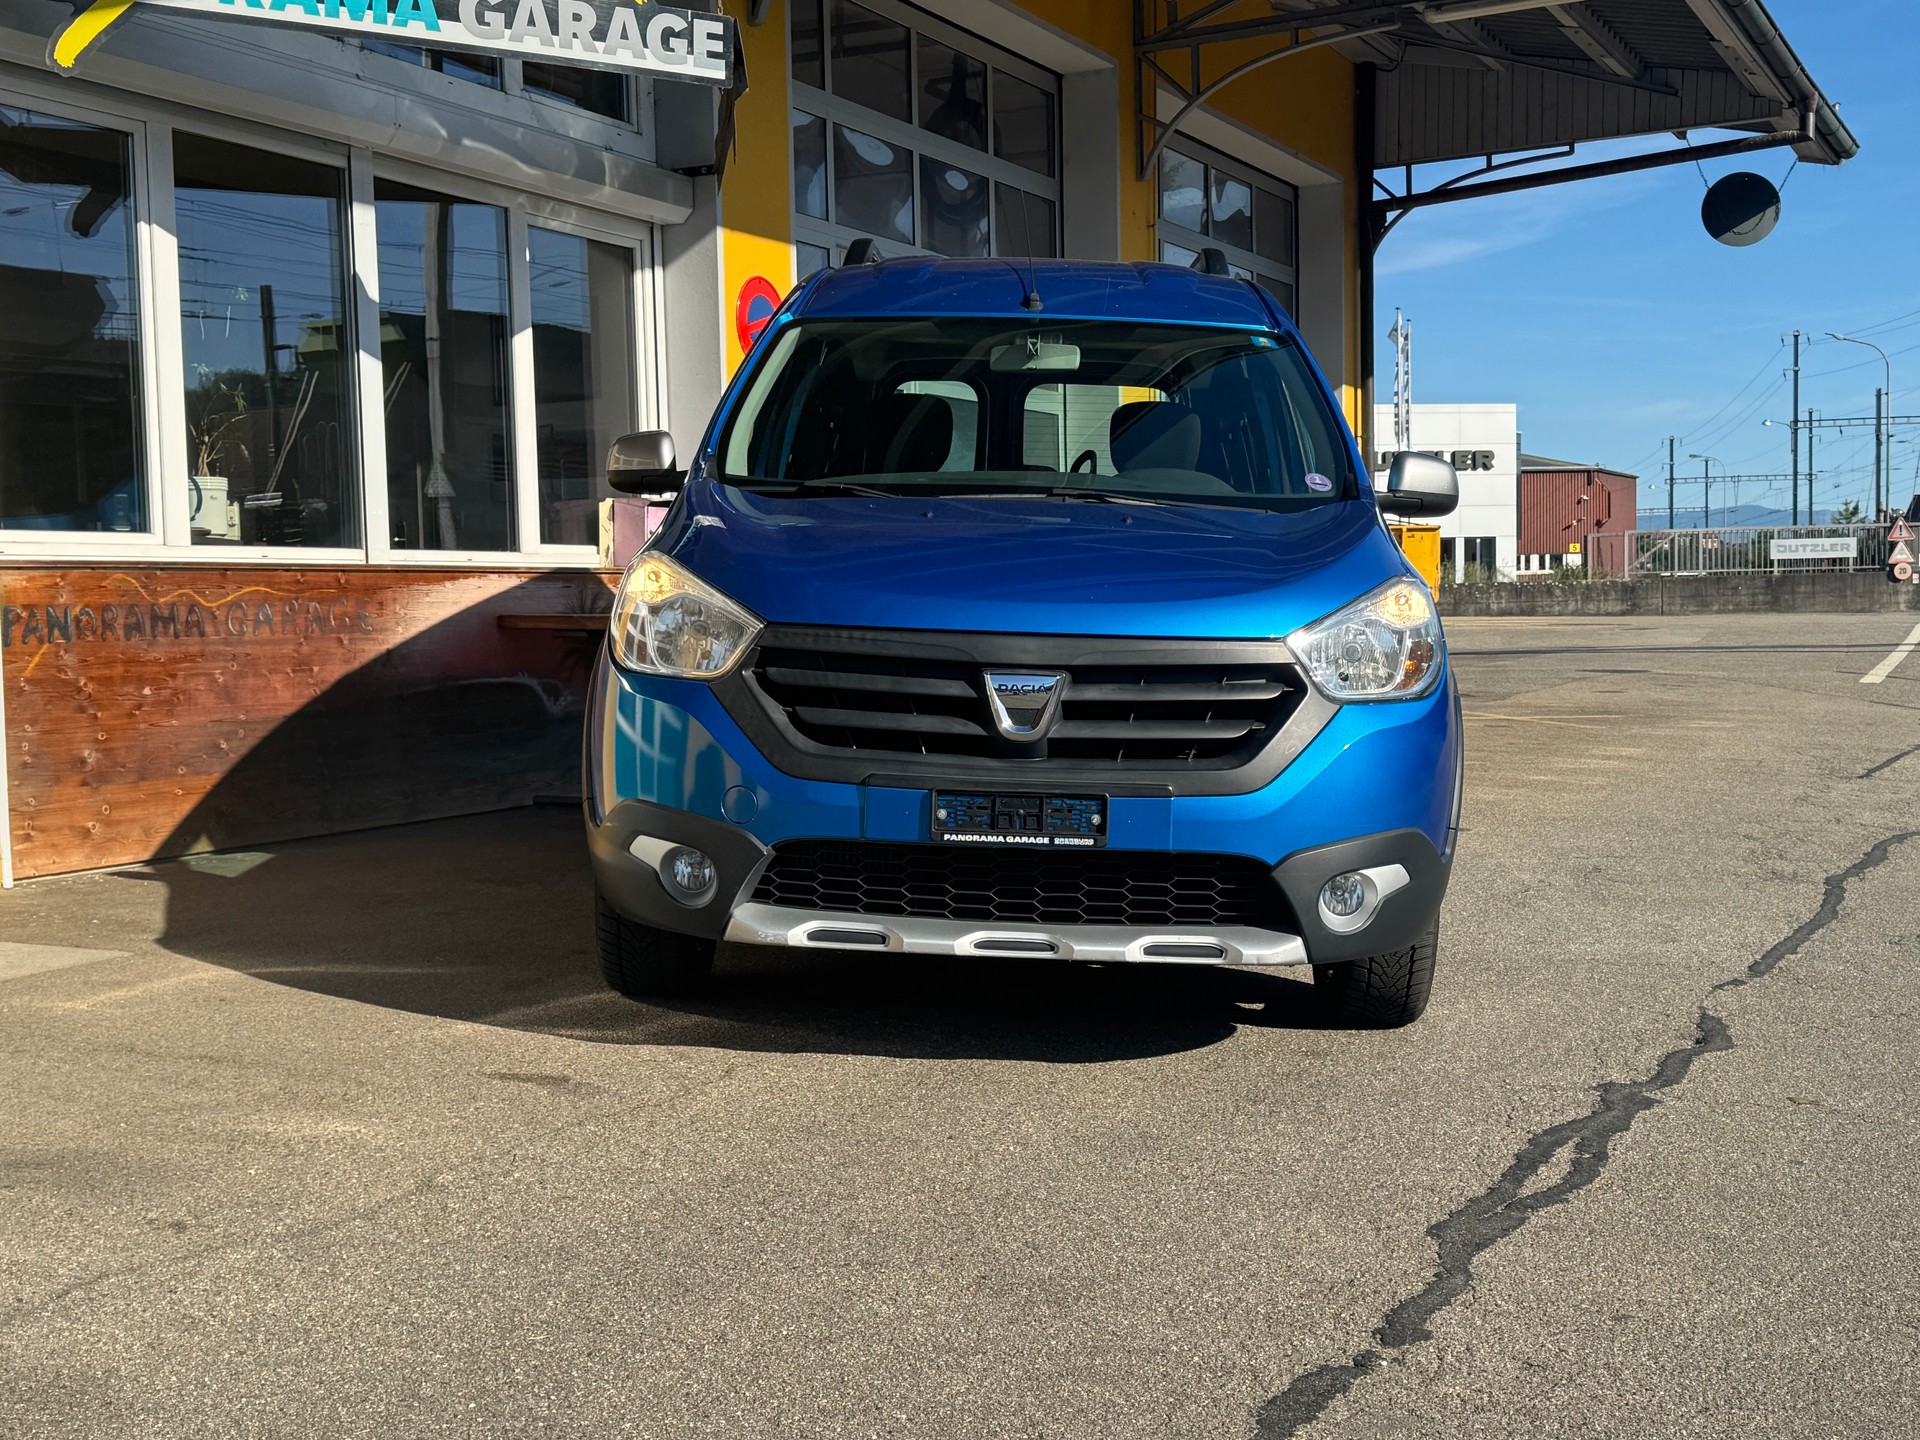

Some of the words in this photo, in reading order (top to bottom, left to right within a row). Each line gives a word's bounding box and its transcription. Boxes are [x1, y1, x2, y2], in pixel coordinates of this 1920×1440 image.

[459, 0, 727, 71] GARAGE
[1572, 544, 1577, 552] 5
[1776, 542, 1851, 554] DUTZLER
[2, 602, 206, 647] PANORAMA
[998, 683, 1048, 694] DACIA
[943, 833, 1005, 844] PANORAMA
[1006, 835, 1050, 844] GARAGE
